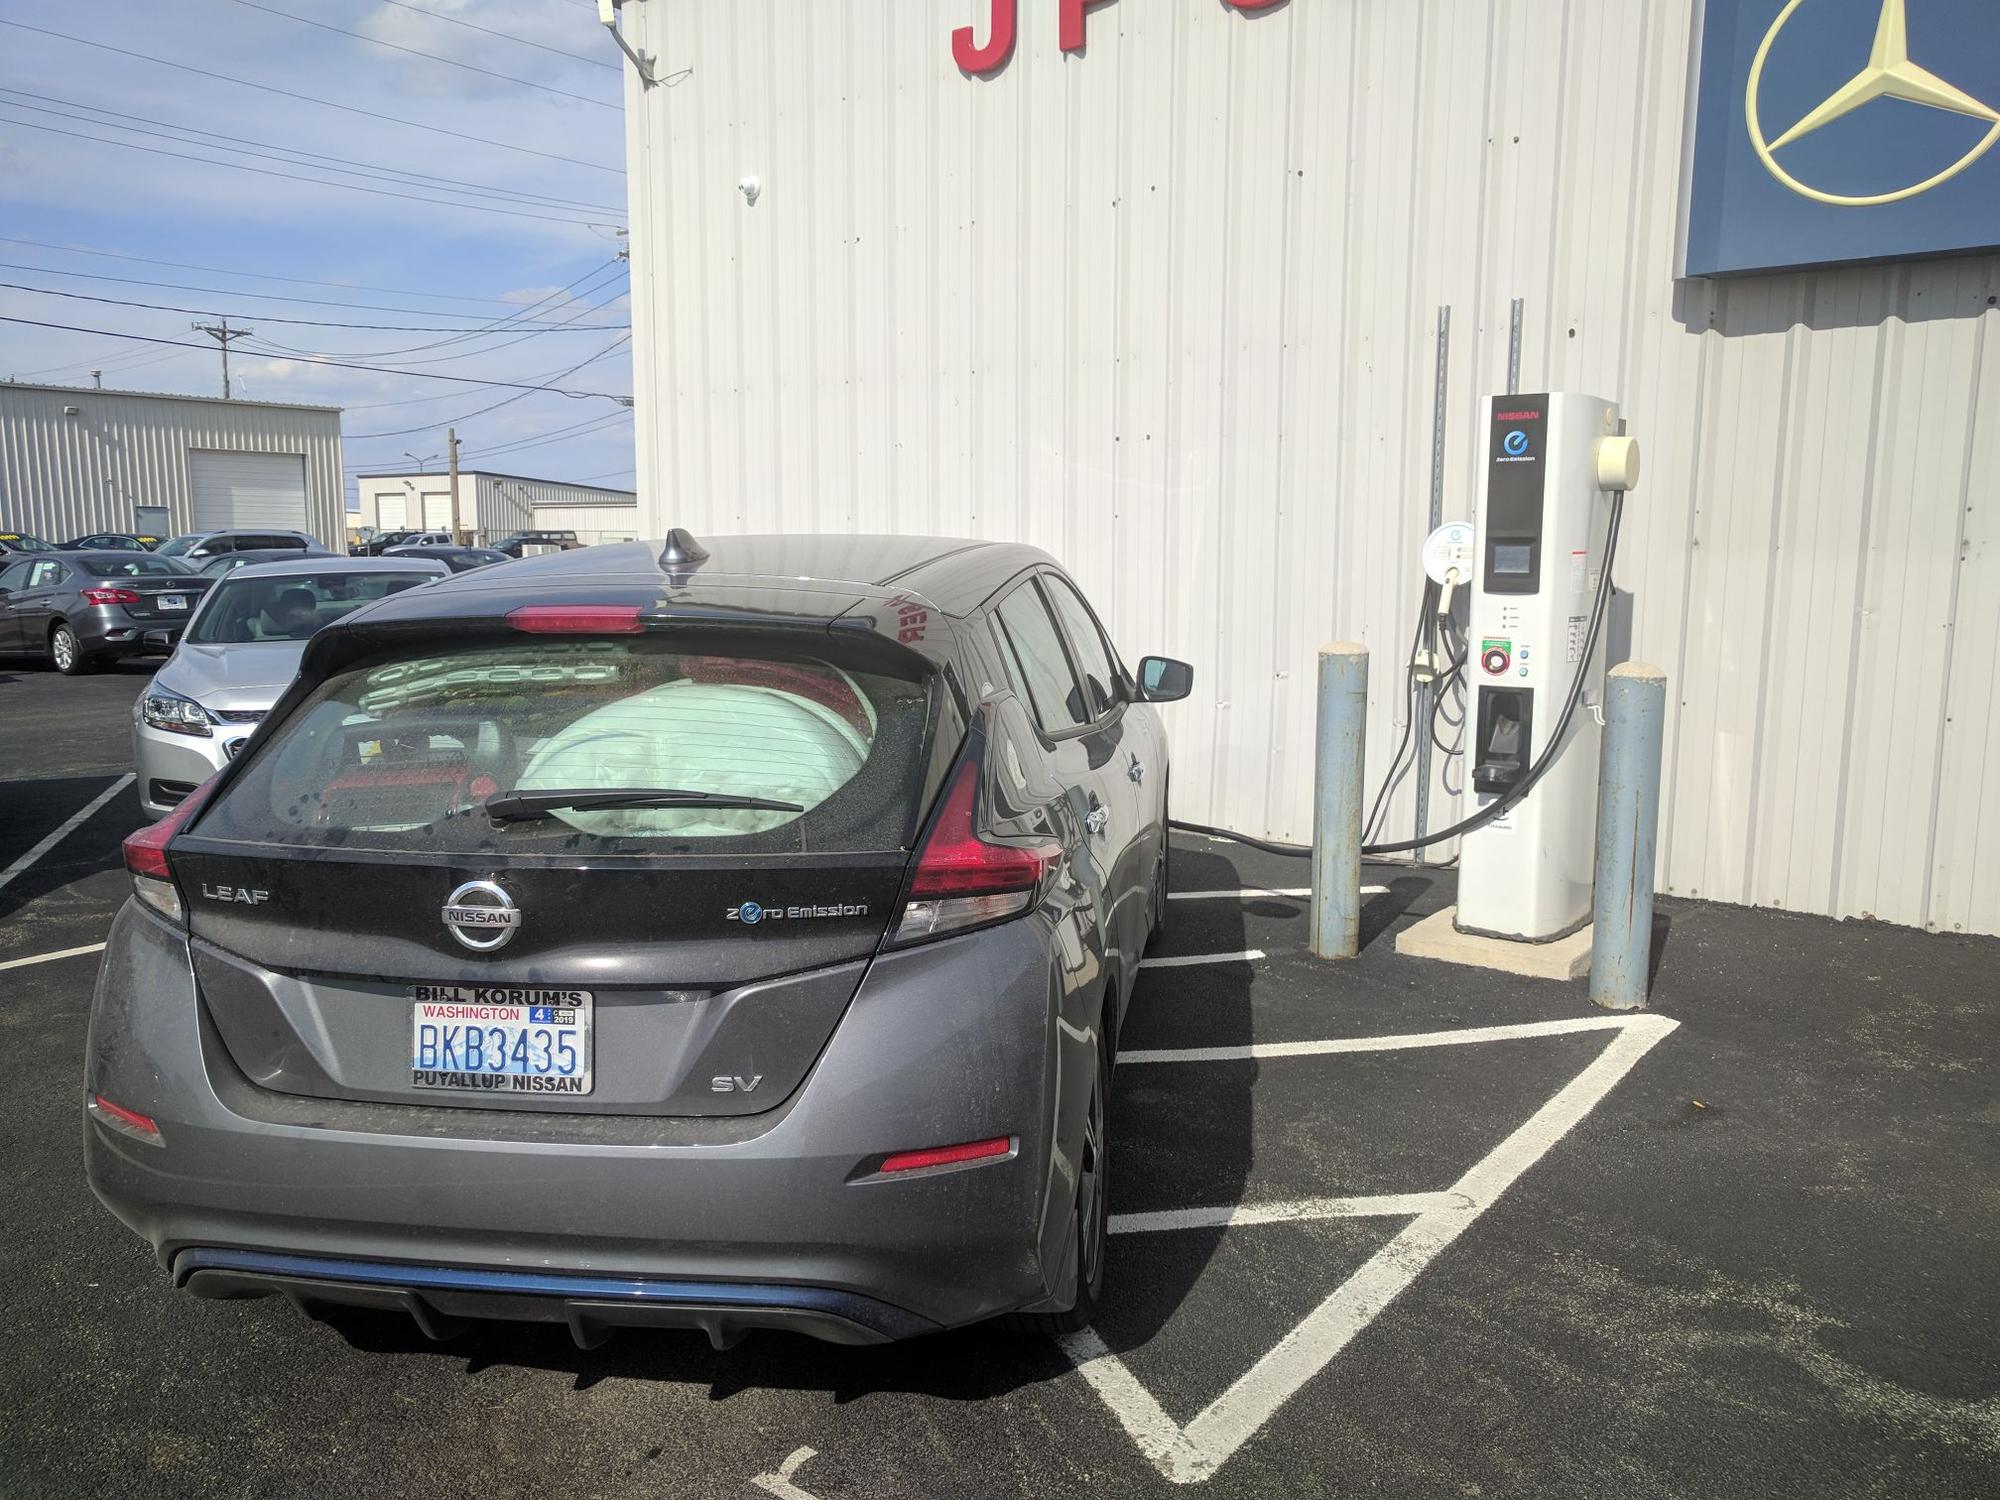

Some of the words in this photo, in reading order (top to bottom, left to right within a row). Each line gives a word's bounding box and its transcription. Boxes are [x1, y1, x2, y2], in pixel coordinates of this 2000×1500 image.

[1497, 411, 1539, 420] NISSAN
[202, 883, 268, 905] LEAF
[448, 911, 512, 923] NISSAN
[415, 986, 466, 1003] BILL
[475, 988, 583, 1007] KORUM'S
[423, 1005, 520, 1021] WASHINGTON
[535, 1008, 544, 1020] 4
[554, 1016, 574, 1024] 2019
[420, 1024, 577, 1075] BKB3435
[413, 1071, 506, 1089] PUYALLUP
[512, 1076, 582, 1093] NISSAN
[711, 1076, 763, 1092] SV
